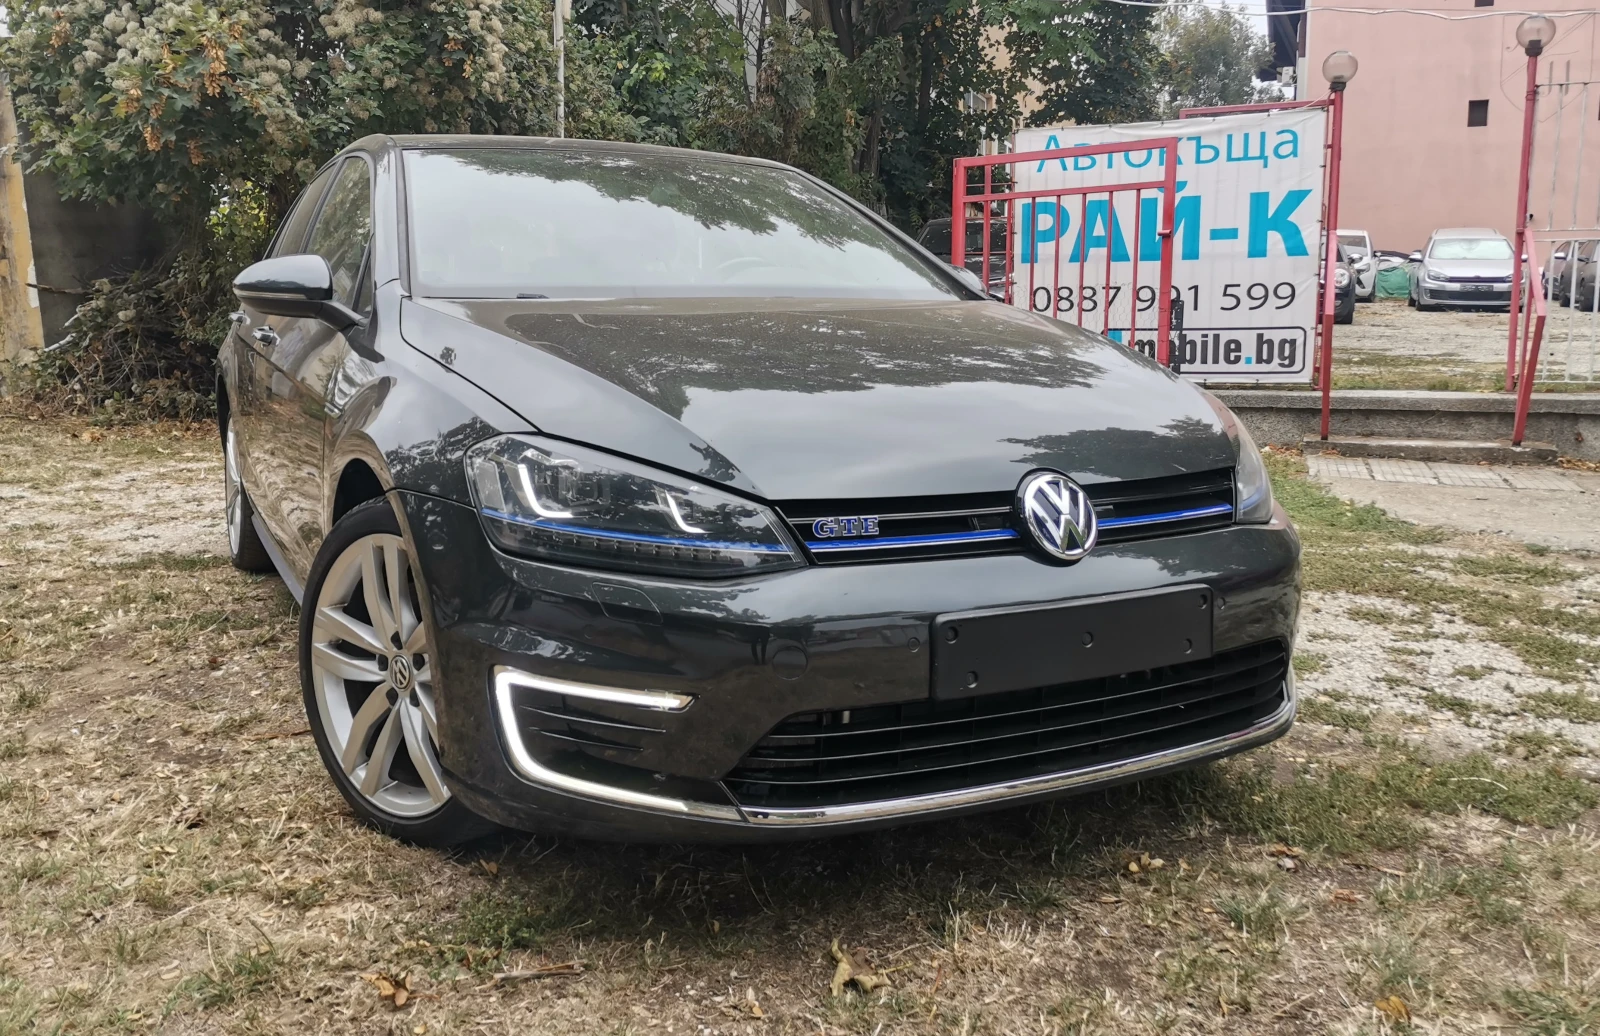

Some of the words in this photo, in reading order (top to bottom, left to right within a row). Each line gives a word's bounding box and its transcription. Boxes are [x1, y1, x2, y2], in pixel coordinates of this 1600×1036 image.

[1021, 180, 1313, 263] РАЙ-К
[1032, 285, 1121, 312] 0887
[1220, 282, 1296, 311] 599
[813, 516, 880, 538] GTE
